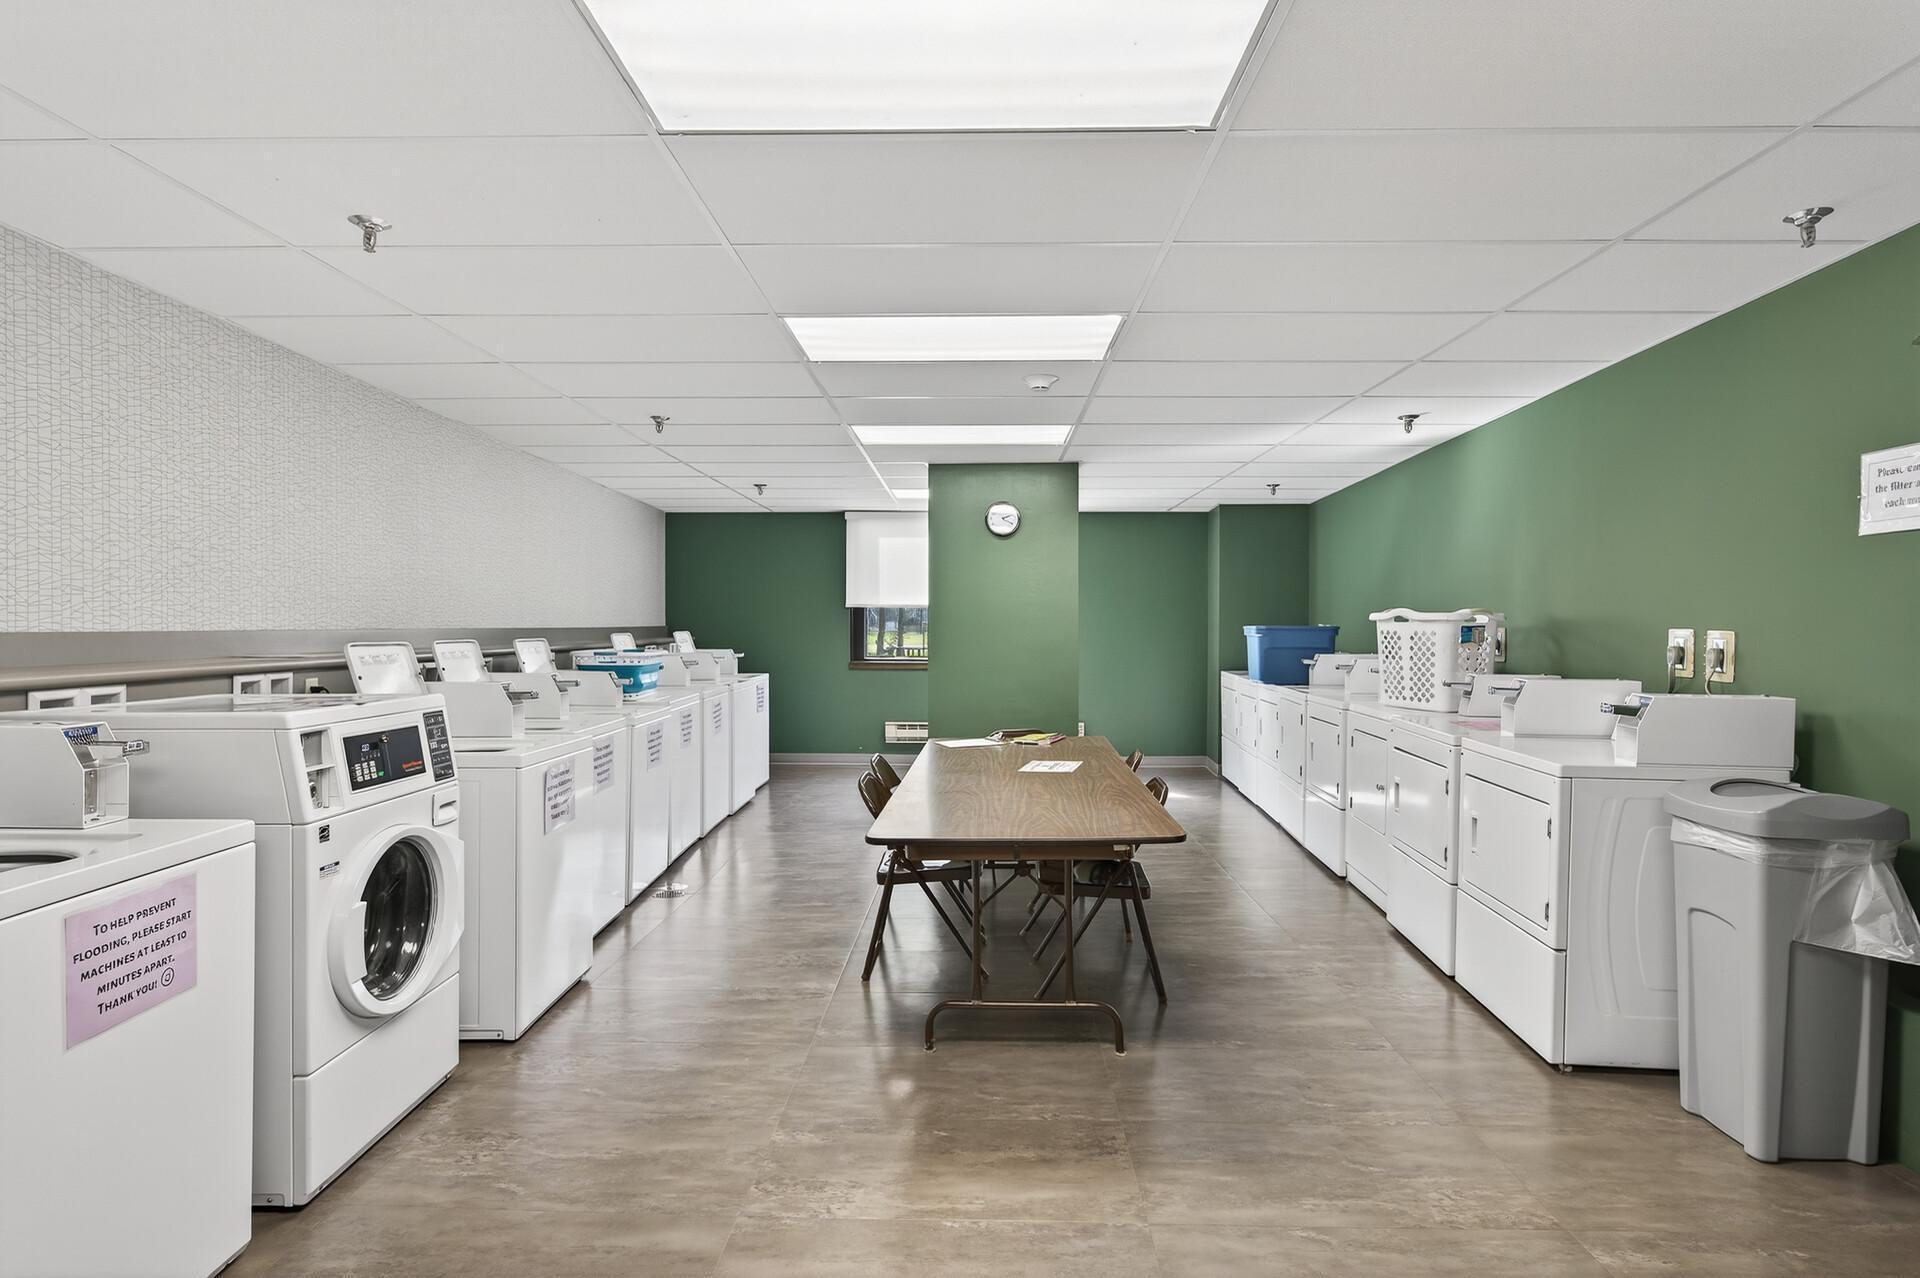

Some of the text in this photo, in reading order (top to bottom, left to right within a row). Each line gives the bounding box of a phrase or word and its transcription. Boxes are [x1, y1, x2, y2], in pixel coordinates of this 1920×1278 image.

[1875, 484, 1887, 493] the
[1890, 481, 1913, 491] filter
[110, 914, 134, 930] HELP
[136, 898, 177, 920] PREVENT
[72, 910, 192, 964] FLOODING, PLEASE START
[80, 930, 187, 982] MACHINES AT LEAST 10
[96, 954, 176, 996] MINUTES APART.
[136, 980, 158, 996] YOU!
